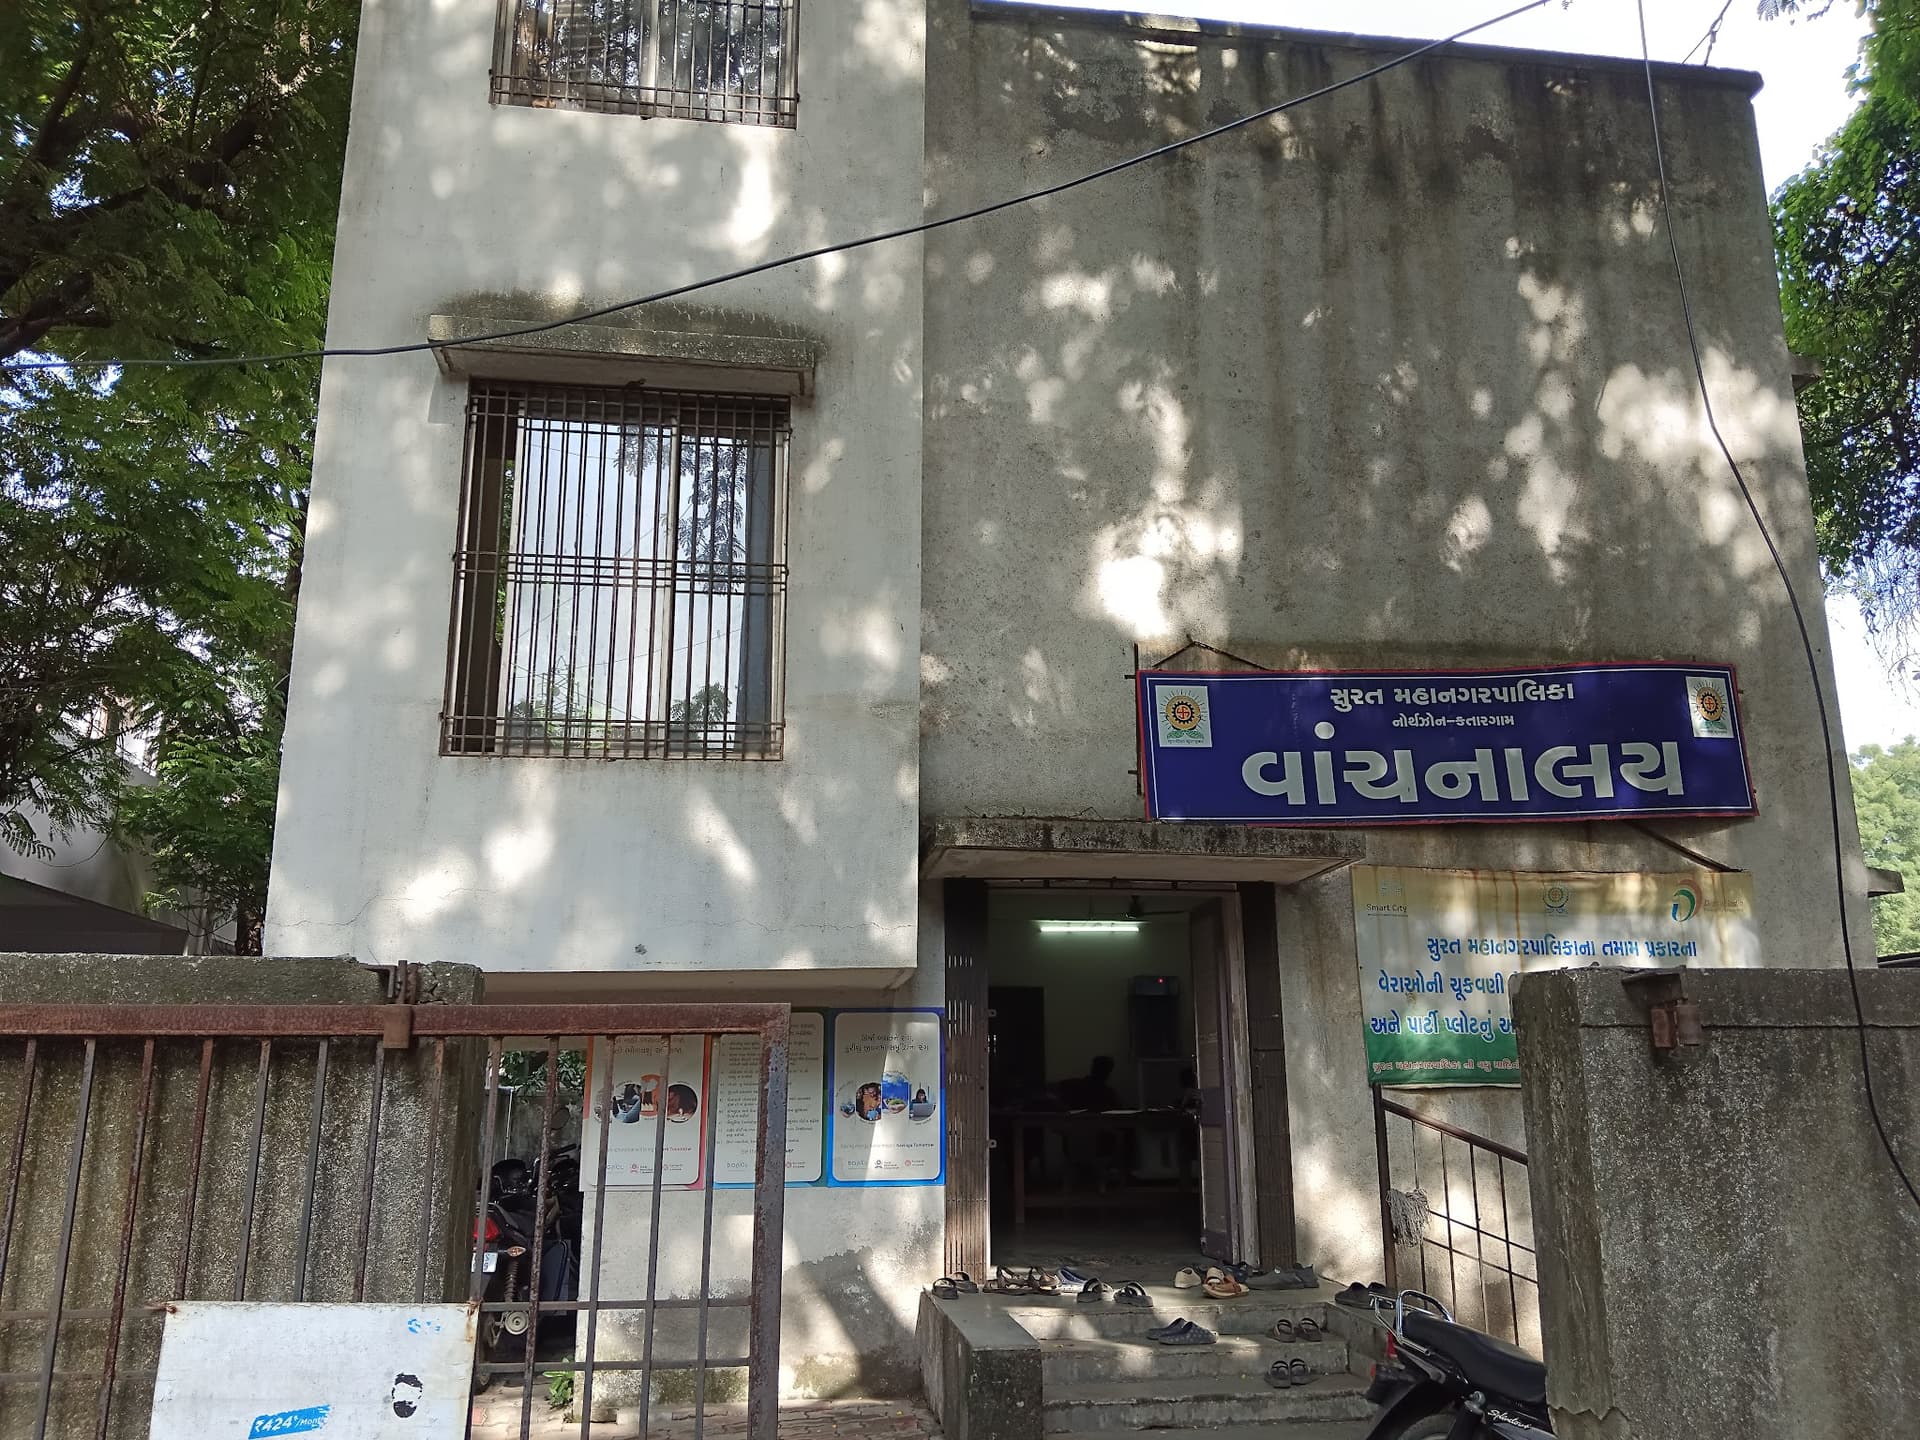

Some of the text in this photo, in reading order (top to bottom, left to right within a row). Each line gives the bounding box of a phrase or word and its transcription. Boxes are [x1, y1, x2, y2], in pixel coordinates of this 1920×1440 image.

[1330, 679, 1575, 712] સુરત મહાનગરપાલિકા
[1241, 721, 1684, 805] વાંચનાલય
[1366, 903, 1408, 913] Smart City
[1427, 933, 1697, 962] સુરત મહાનગરપાલિકાના તમામ પ્રકારના
[1378, 970, 1505, 1001] વેરાઓની ચૂકવણી
[1371, 1009, 1401, 1034] અને
[1406, 1009, 1439, 1034] પાર્ટી
[1445, 1009, 1495, 1042] પ્લોટનું
